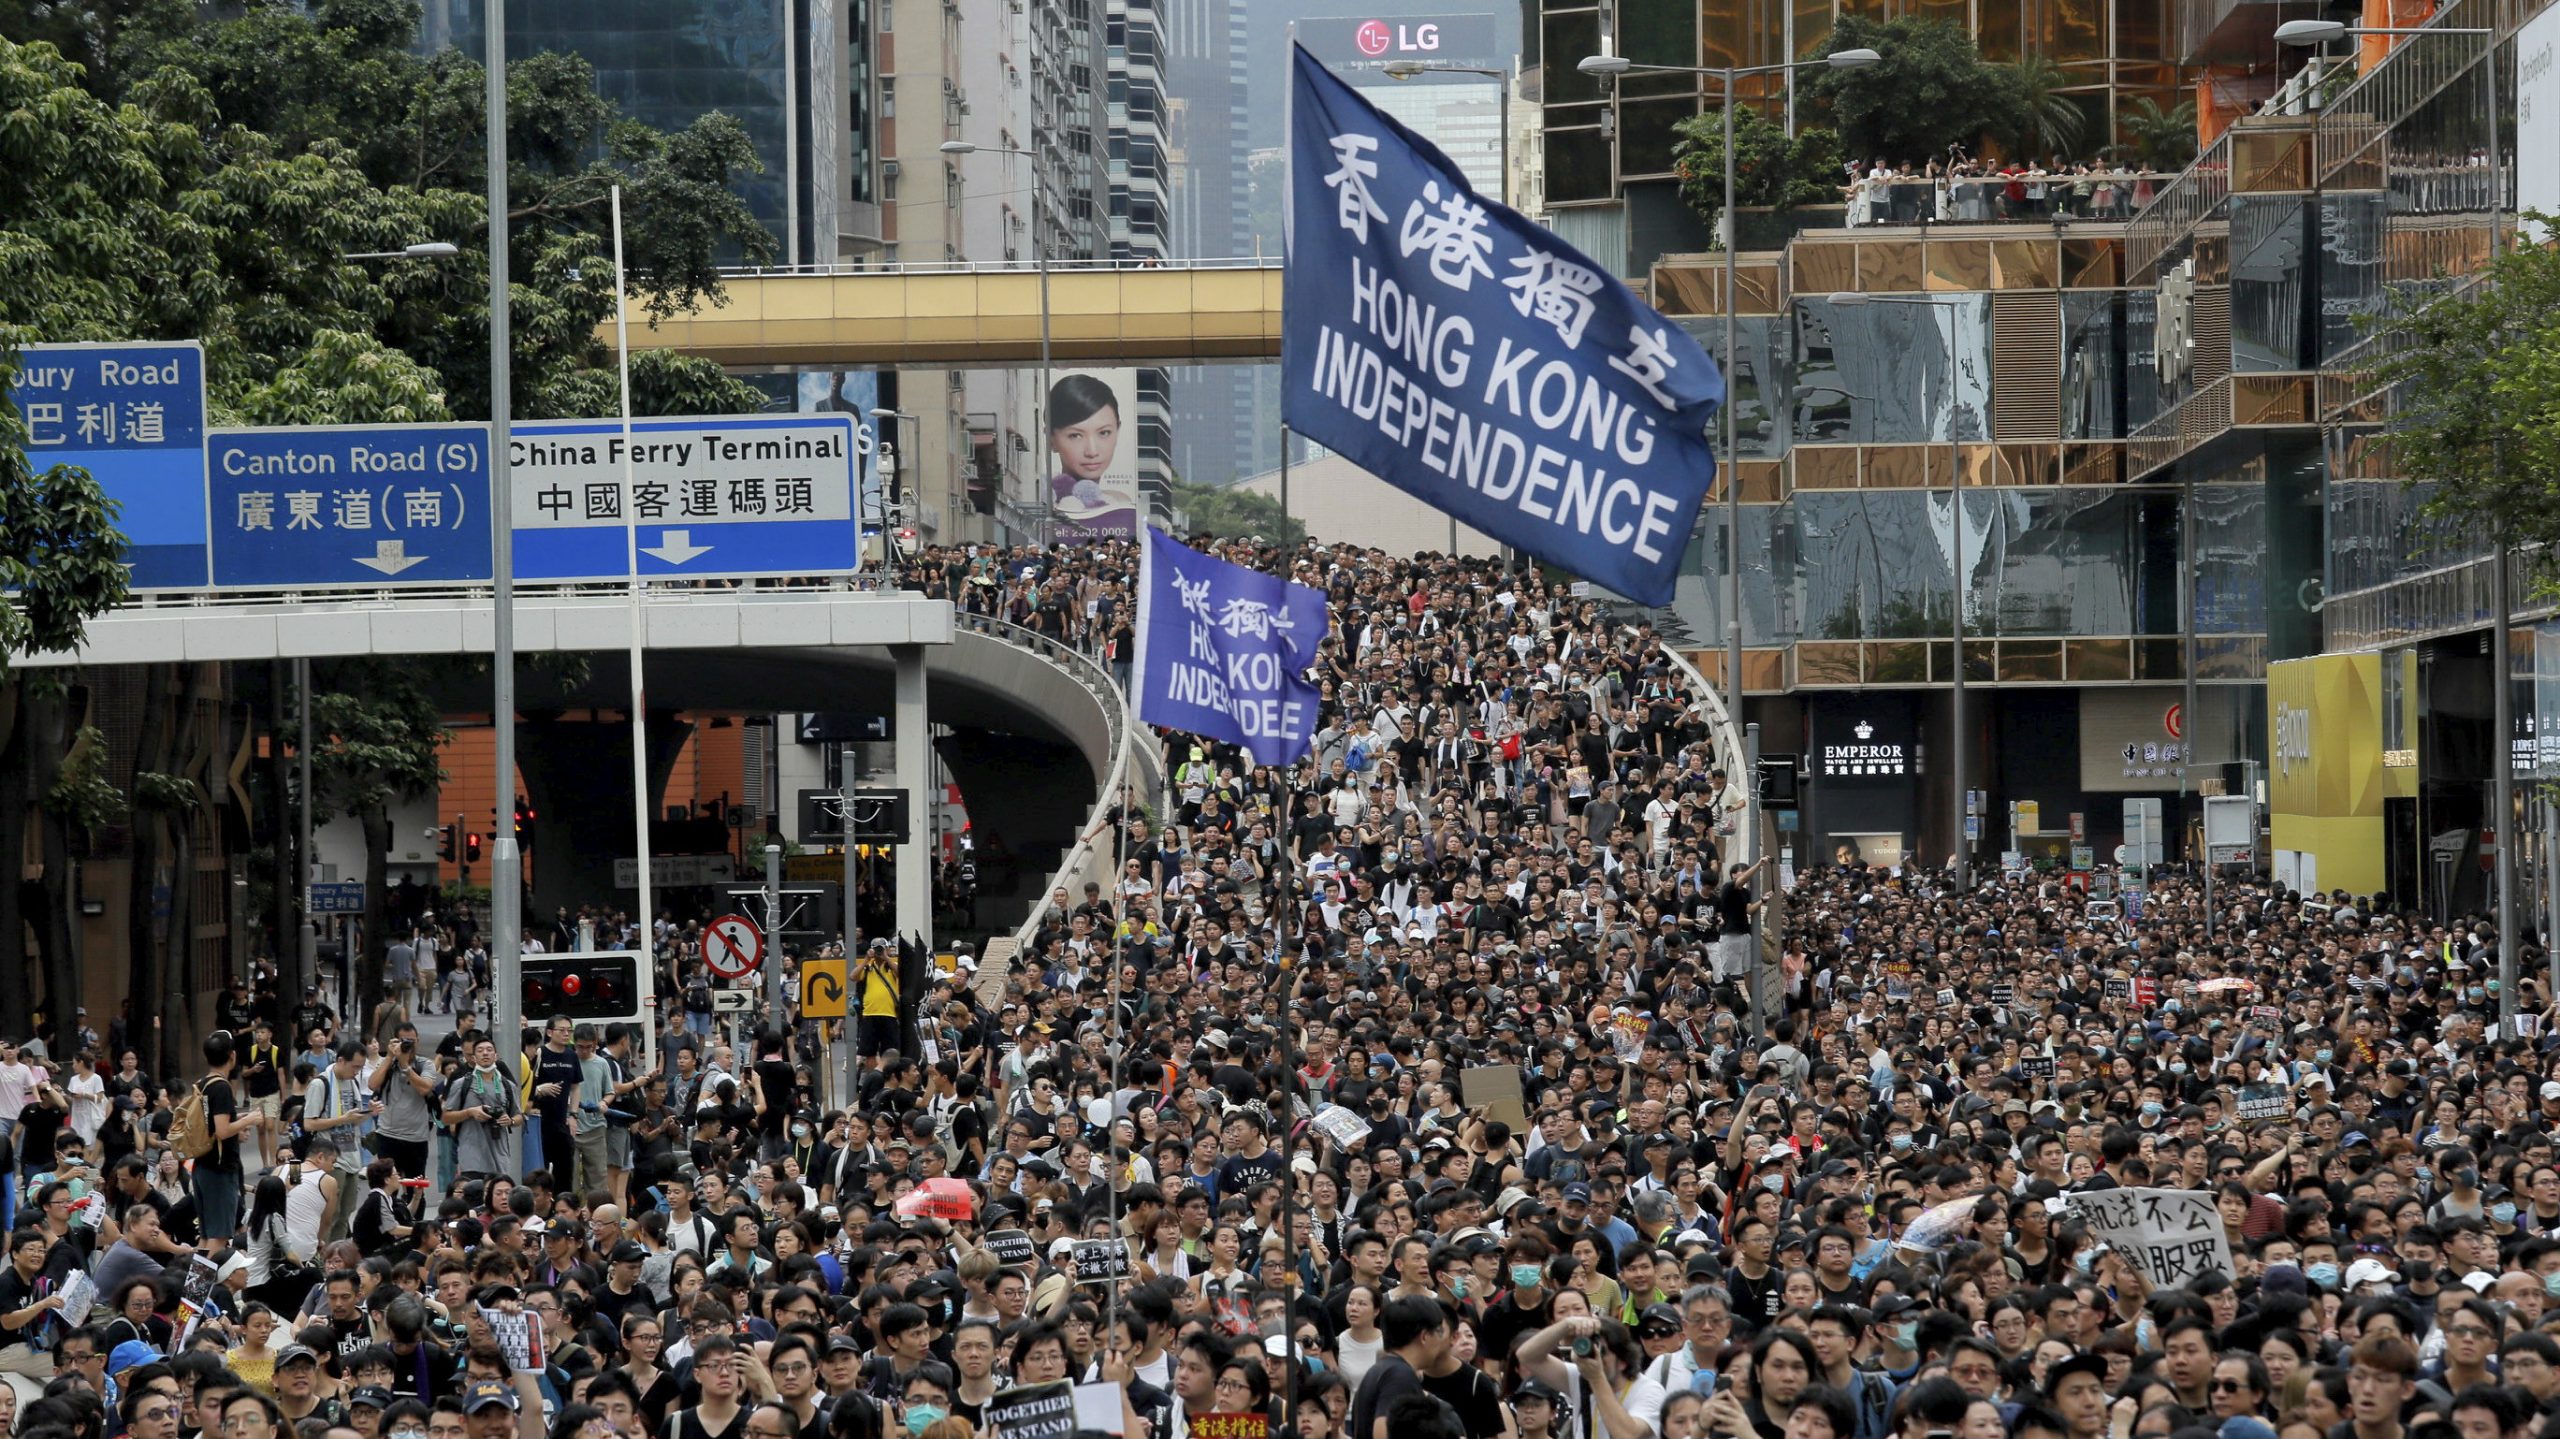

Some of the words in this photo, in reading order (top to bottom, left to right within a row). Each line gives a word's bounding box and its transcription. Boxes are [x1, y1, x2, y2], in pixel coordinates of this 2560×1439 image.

[1399, 24, 1439, 50] LG
[100, 359, 179, 386] Road
[1352, 256, 1475, 388] HONG
[1484, 337, 1656, 465] KONG
[510, 439, 597, 468] China
[608, 438, 692, 467] Ferry
[703, 435, 842, 462] Terminal
[1312, 325, 1678, 564] INDEPENDENCE
[223, 448, 335, 476] Canton
[351, 446, 425, 473] Road
[436, 443, 478, 473] (S)
[537, 477, 814, 521] 中國客運碼頭
[1825, 745, 1903, 758] EMPEROR
[1234, 1166, 1272, 1183] TORONTO
[984, 1237, 1030, 1249] TOGETHER
[1001, 1248, 1030, 1258] STAND
[987, 1395, 1072, 1425] TOGETHER
[1017, 1417, 1072, 1438] STAND
